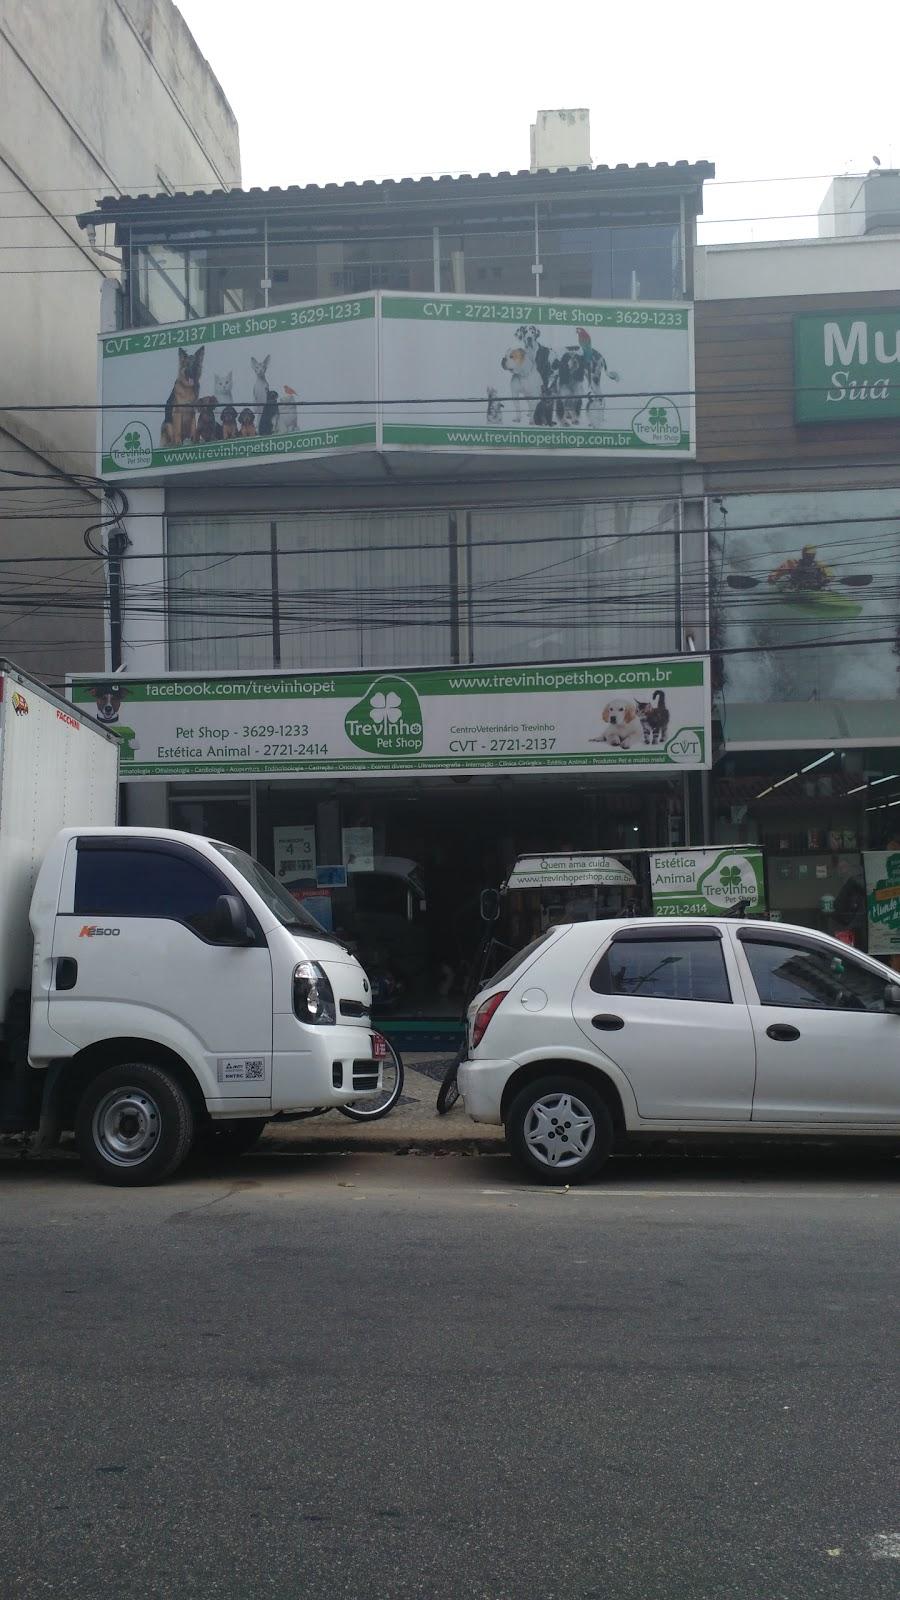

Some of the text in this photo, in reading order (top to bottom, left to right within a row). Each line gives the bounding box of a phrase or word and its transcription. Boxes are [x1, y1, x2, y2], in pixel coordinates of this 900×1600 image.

[423, 303, 451, 317] CVT
[464, 304, 532, 320] 2721-2137
[548, 309, 567, 322] Pet
[569, 309, 603, 325] Shop
[616, 311, 682, 326] 3629-1233
[105, 338, 132, 354] CVT
[143, 327, 207, 349] 2721-2137
[222, 322, 241, 336] Pet
[245, 317, 277, 334] Shop
[290, 302, 361, 327] 3629-1233
[826, 371, 890, 402] Sua
[634, 422, 679, 435] Trevinho
[447, 430, 632, 447] www.trevinhopetshop.com.br
[652, 433, 680, 442] Pet Shop
[113, 445, 151, 460] Trevinho
[163, 433, 339, 464] www.trevinhopetshop.com.br
[127, 455, 151, 466] Pet Shop
[449, 668, 672, 689] www.trevinhopetshop.com.br
[146, 679, 336, 697] facebook.com/trevinhopet
[176, 727, 194, 739] Pet
[199, 726, 230, 741] Shop
[242, 724, 309, 738] 3629-1233
[346, 719, 423, 736] Trevinho
[520, 723, 556, 733] Trevinho
[157, 745, 204, 759] Estética
[207, 745, 251, 757] Animal
[264, 743, 329, 756] 2721-2414
[376, 737, 423, 750] Pet Shop
[449, 740, 478, 753] CVT
[490, 738, 556, 751] 2721-2137
[670, 742, 698, 754] CVT
[540, 861, 566, 869] Quem
[588, 859, 610, 868] cuida
[655, 858, 695, 869] Estética
[655, 872, 695, 884] Animal
[704, 884, 756, 896] Trevinho
[656, 904, 707, 915] 2721-2414
